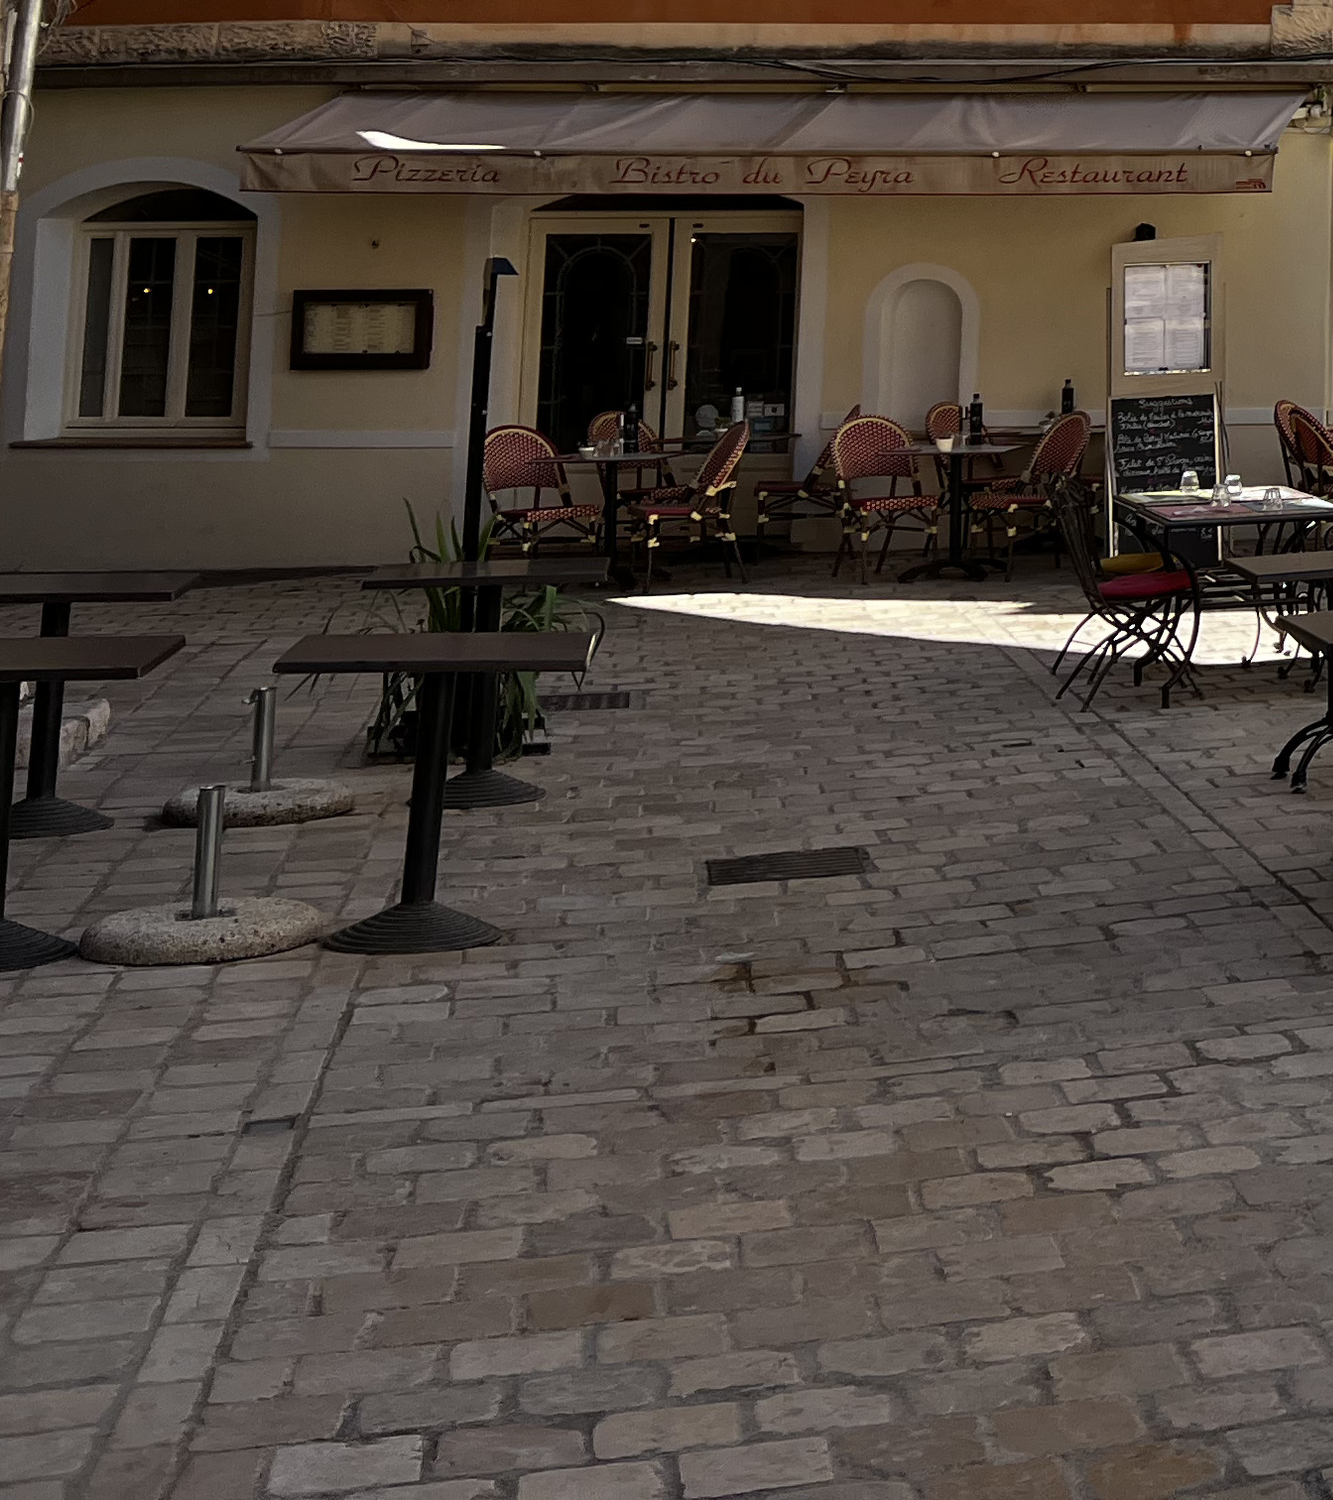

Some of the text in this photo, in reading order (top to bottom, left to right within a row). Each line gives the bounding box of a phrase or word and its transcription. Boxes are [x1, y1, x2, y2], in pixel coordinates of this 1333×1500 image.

[353, 156, 501, 184] Pizzeria
[609, 157, 914, 192] Bistro du Peyra
[999, 157, 1189, 188] Restaurant
